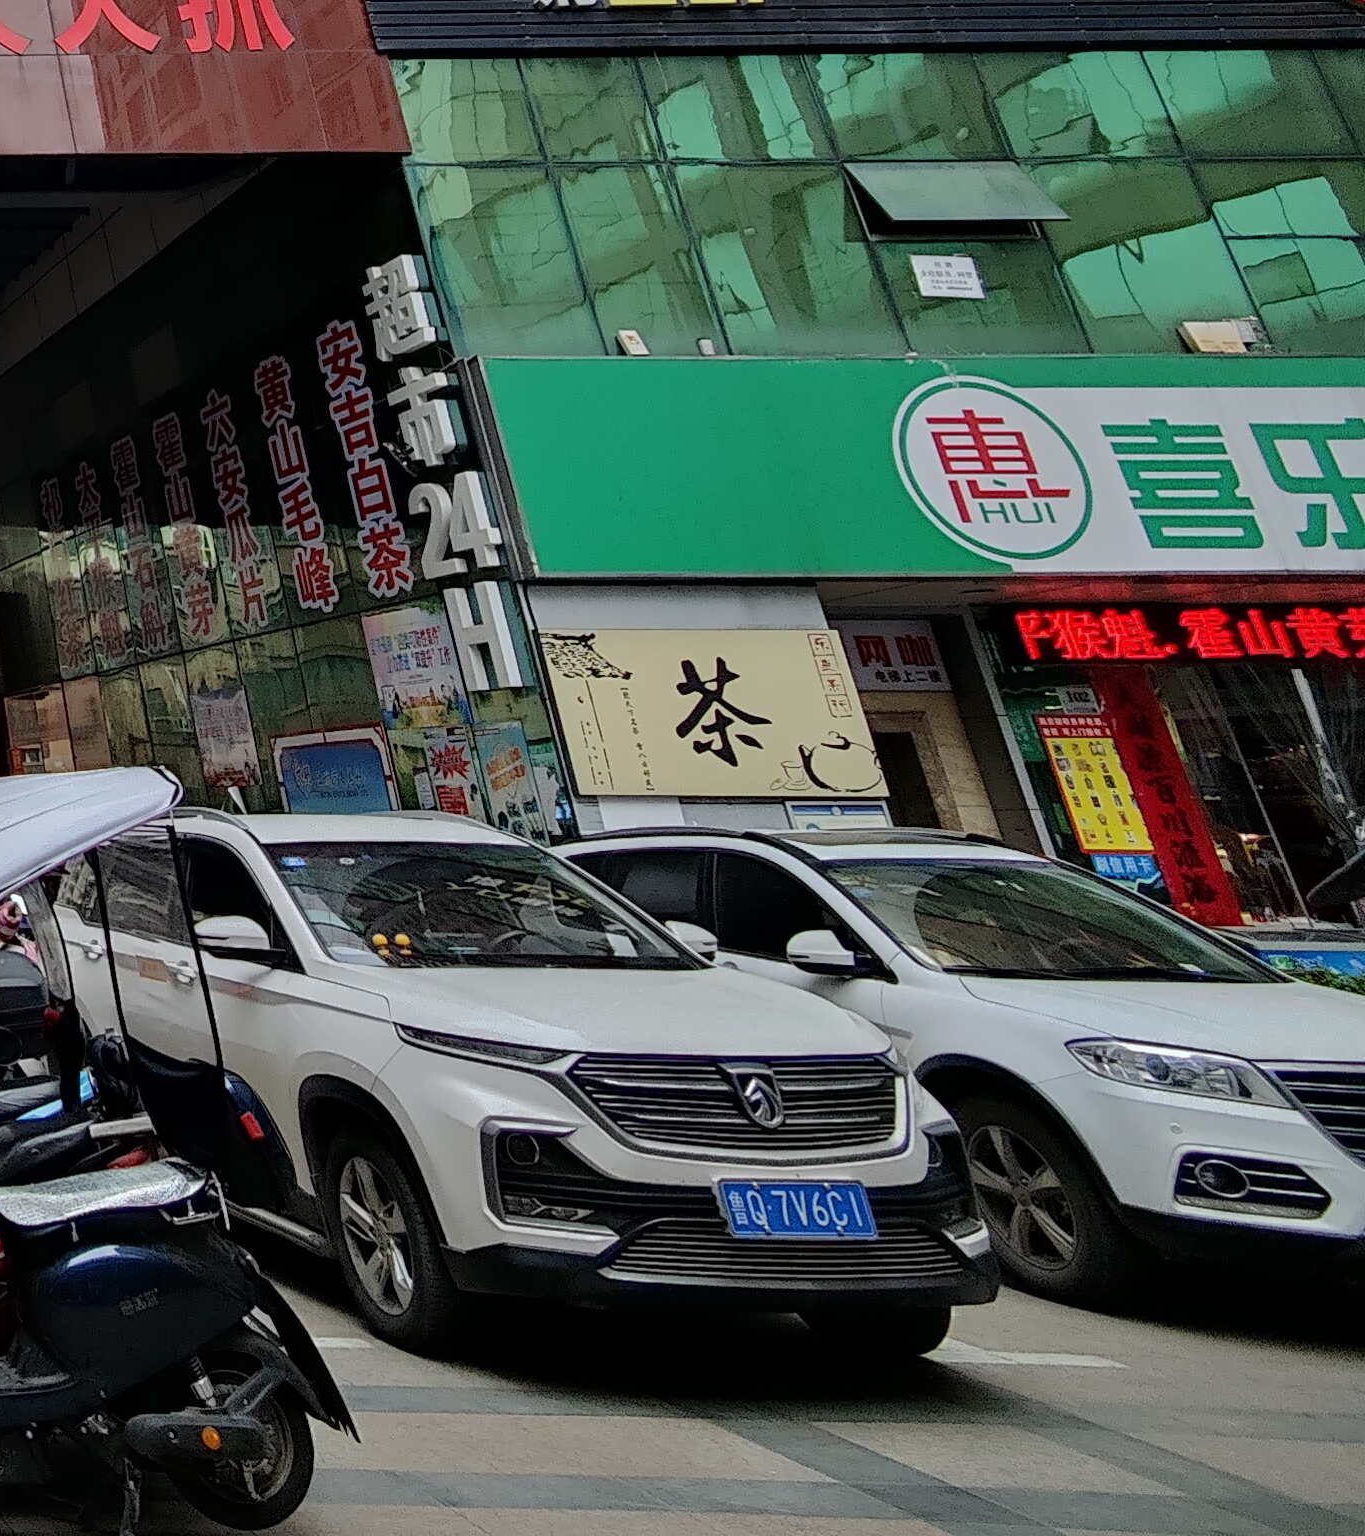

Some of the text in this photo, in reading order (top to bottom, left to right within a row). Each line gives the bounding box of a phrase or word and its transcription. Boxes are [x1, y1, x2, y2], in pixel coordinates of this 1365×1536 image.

[111, 435, 169, 655] 霍山石斛
[153, 412, 214, 638] 霍山黄芽
[200, 388, 268, 628] 六安瓜片
[254, 355, 340, 611] 黄山毛峰
[316, 319, 414, 598] 安吉白茶
[979, 502, 1056, 524] HUI
[1101, 418, 1365, 550] 喜乐
[676, 657, 772, 768] 茶
[853, 634, 937, 668] 网咖
[875, 670, 943, 683] 电梯上二楼
